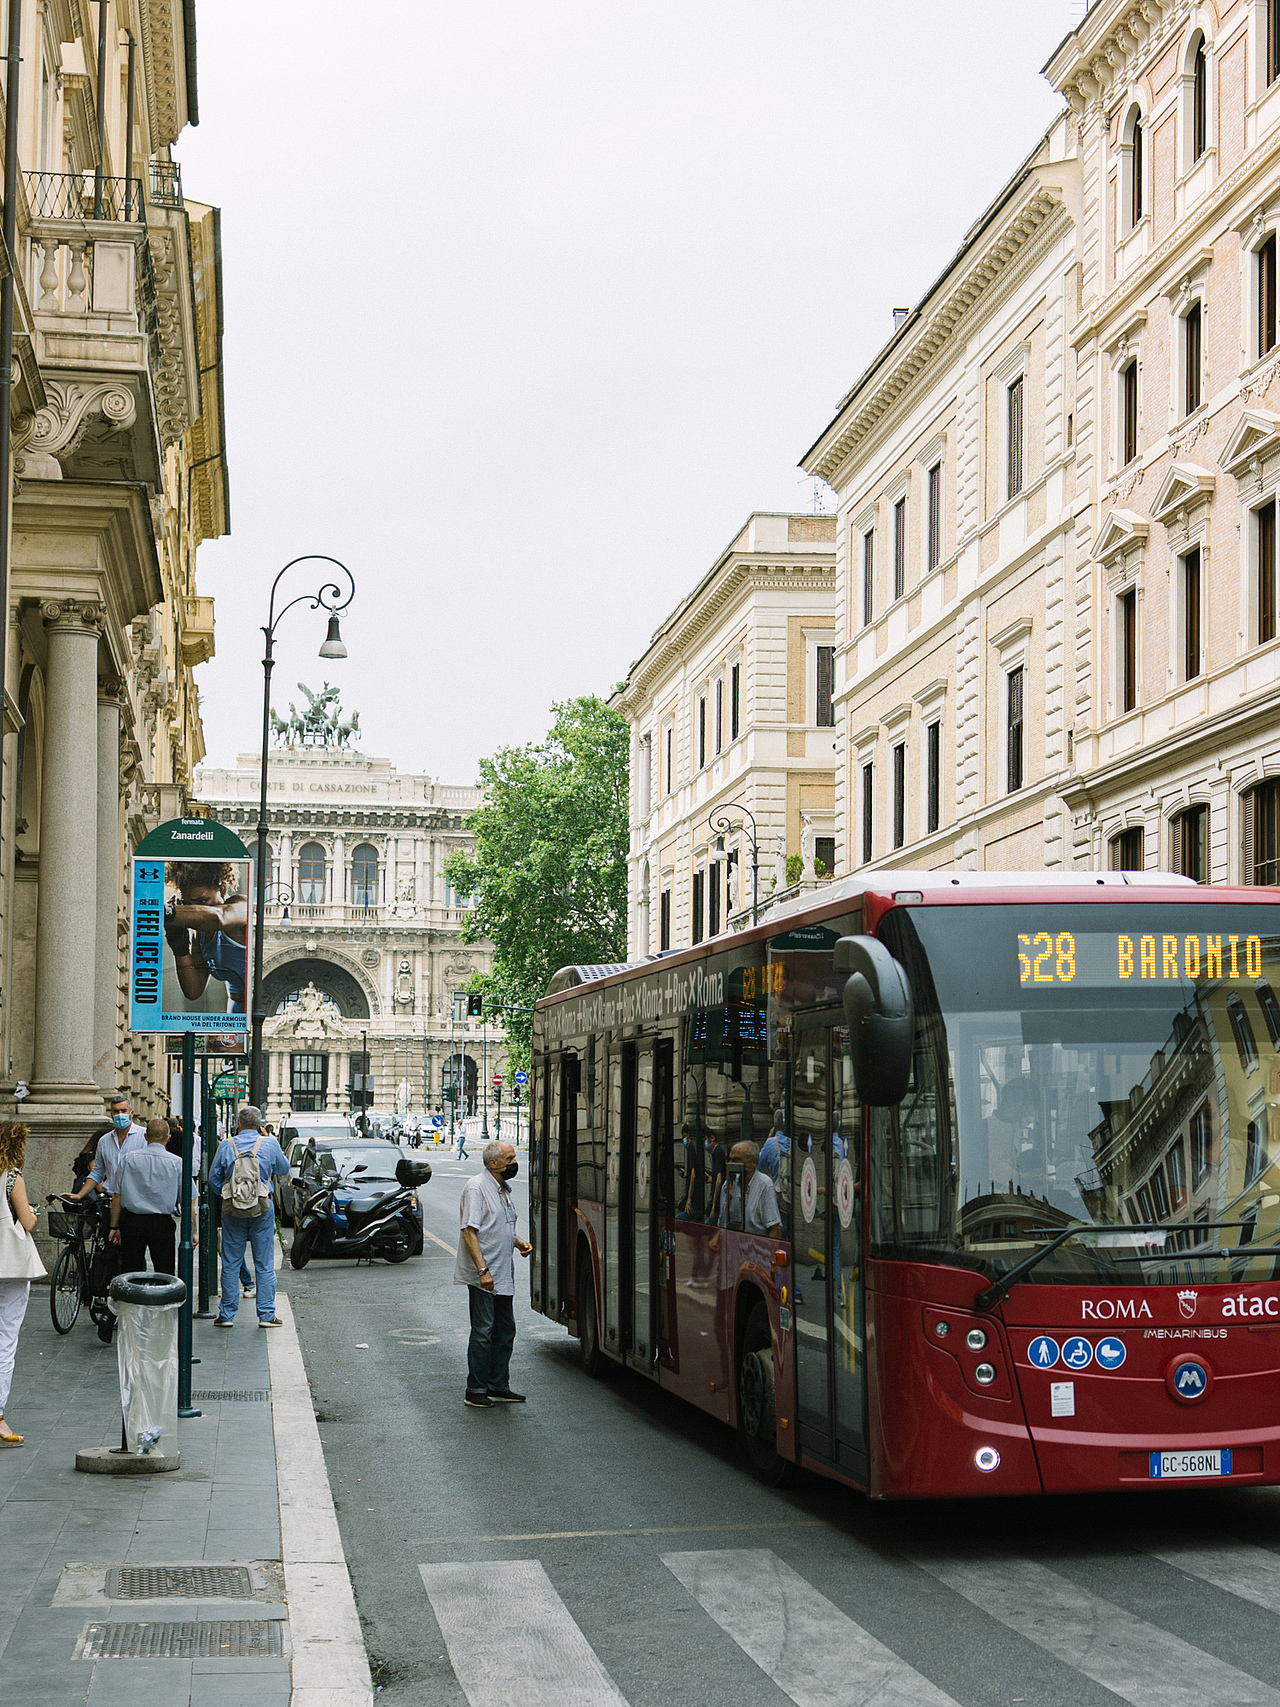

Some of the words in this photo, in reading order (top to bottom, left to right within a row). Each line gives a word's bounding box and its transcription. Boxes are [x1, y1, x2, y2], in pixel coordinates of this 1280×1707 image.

[292, 782, 304, 791] DI
[309, 782, 378, 794] CASSAZIONE
[171, 830, 214, 841] Zanardelli
[136, 909, 160, 938] FEEL
[135, 942, 160, 964] ICE
[1118, 934, 1262, 979] BARONIO
[134, 967, 159, 1004] COLD
[1080, 1299, 1154, 1320] ROMA
[1221, 1293, 1279, 1317] atac
[1147, 1329, 1228, 1339] MENARINIBUS
